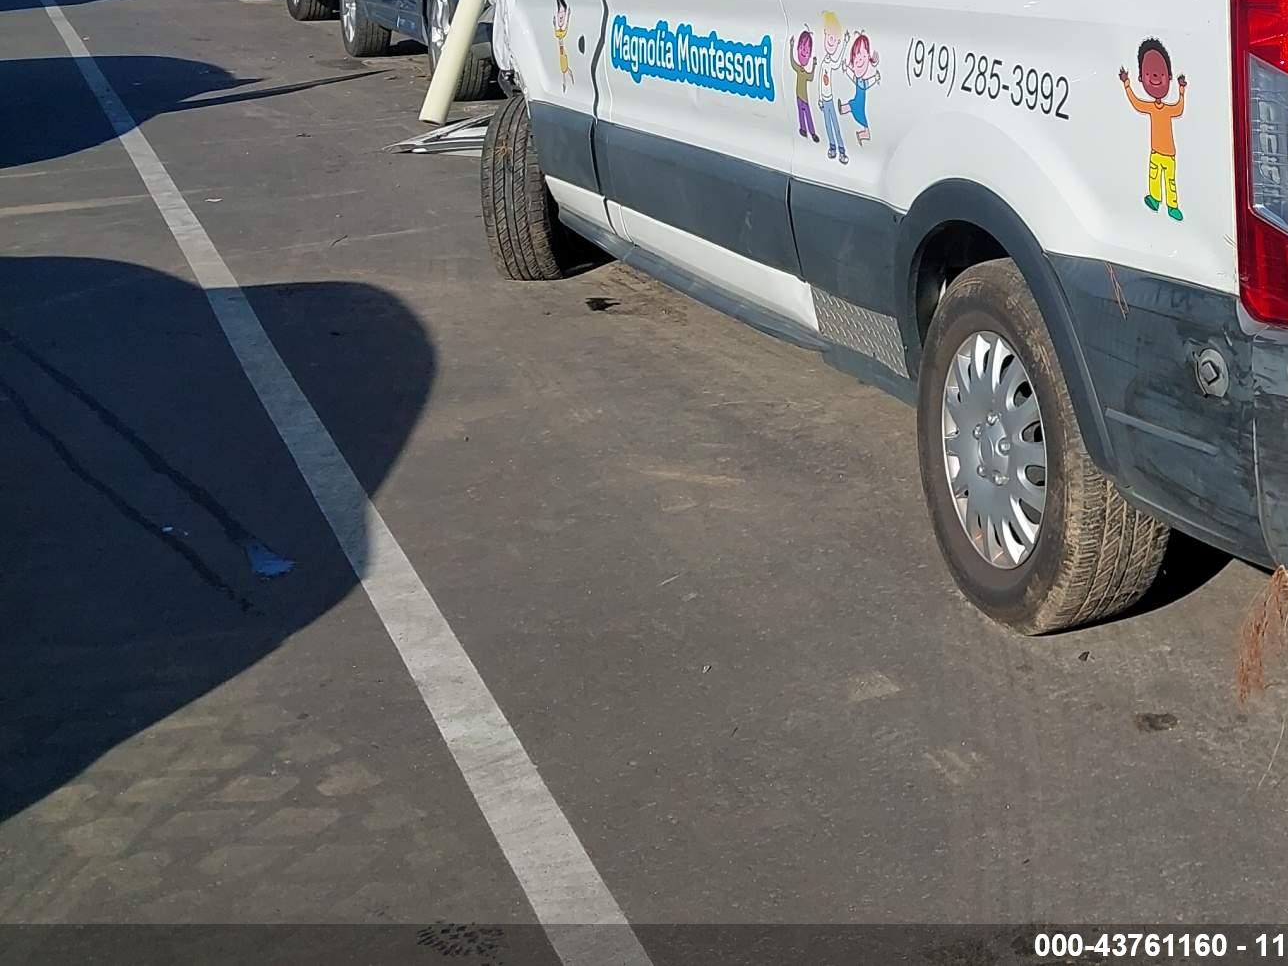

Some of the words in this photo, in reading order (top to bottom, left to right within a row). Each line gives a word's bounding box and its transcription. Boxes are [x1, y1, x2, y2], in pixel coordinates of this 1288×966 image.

[613, 24, 675, 73] Magnolia
[677, 33, 770, 88] Montessori
[906, 37, 957, 97] (919)
[961, 52, 1070, 120] 285-3992
